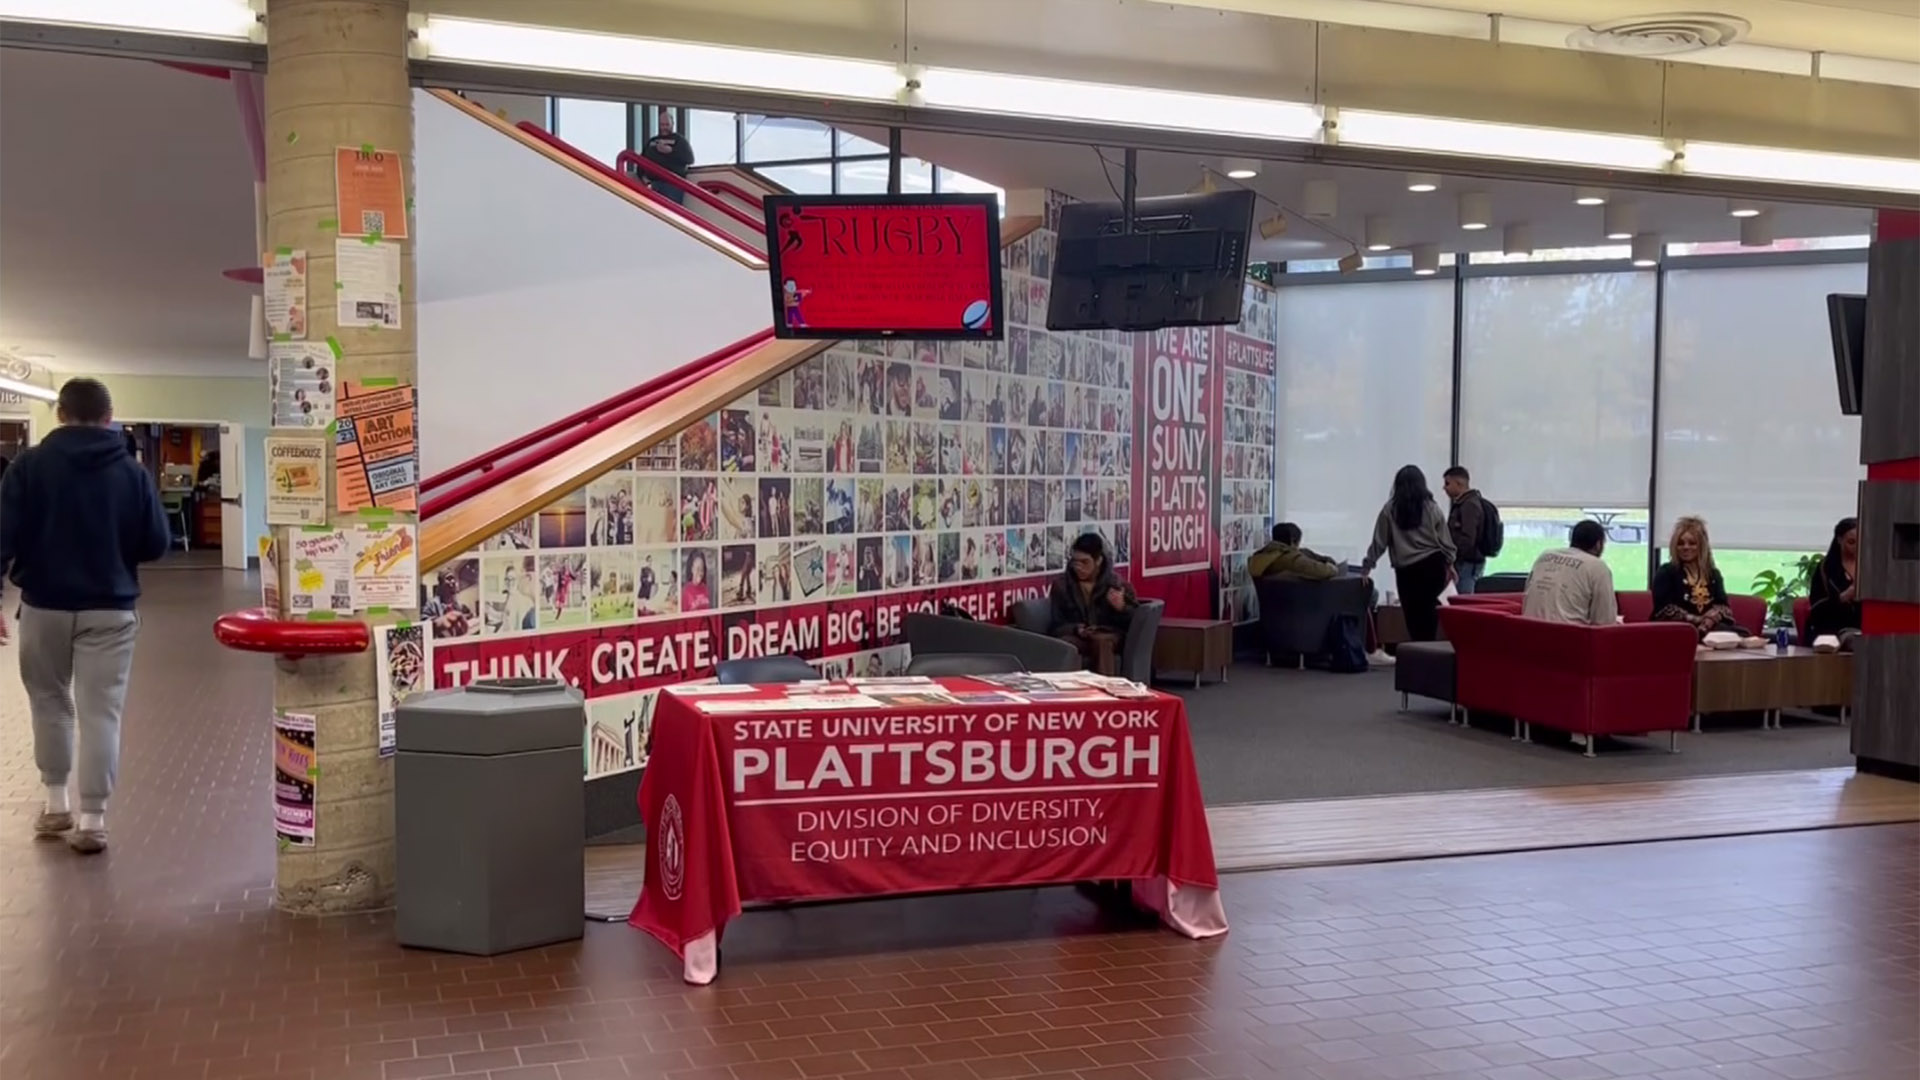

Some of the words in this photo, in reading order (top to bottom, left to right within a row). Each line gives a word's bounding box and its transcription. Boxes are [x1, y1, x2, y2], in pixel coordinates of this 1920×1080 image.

[355, 150, 384, 163] TRO
[819, 215, 974, 256] RUGBY
[1155, 327, 1177, 353] WE
[1181, 327, 1208, 361] ARE
[1227, 337, 1274, 371] #PLATTSLIFE
[1152, 355, 1207, 424] ONE
[363, 425, 411, 447] AUCTION
[366, 415, 394, 433] ART
[271, 446, 322, 460] COFFEEHOUSE
[1151, 424, 1206, 471] SUNY
[371, 466, 406, 480] ORIGINAL
[1151, 475, 1206, 511] PLATTS
[1150, 515, 1205, 553] BURGH
[444, 648, 580, 688] THINK.
[591, 630, 718, 684] CREATE.
[728, 615, 819, 661] DREAM
[827, 610, 869, 646] BIG.
[876, 605, 900, 640] BE
[734, 718, 813, 740] STATE
[822, 714, 977, 738] UNIVERSITY
[984, 713, 1019, 732] OF
[1027, 711, 1085, 731] NEW
[1092, 710, 1159, 729] YORK
[733, 735, 1160, 793] PLATTSBURGH
[798, 806, 919, 832] DIVISION
[928, 803, 963, 825] OF
[972, 797, 1105, 823] DIVERSITY,
[791, 836, 893, 864] EQUITY
[901, 833, 961, 855] AND
[970, 826, 1108, 852] INCLUSION
